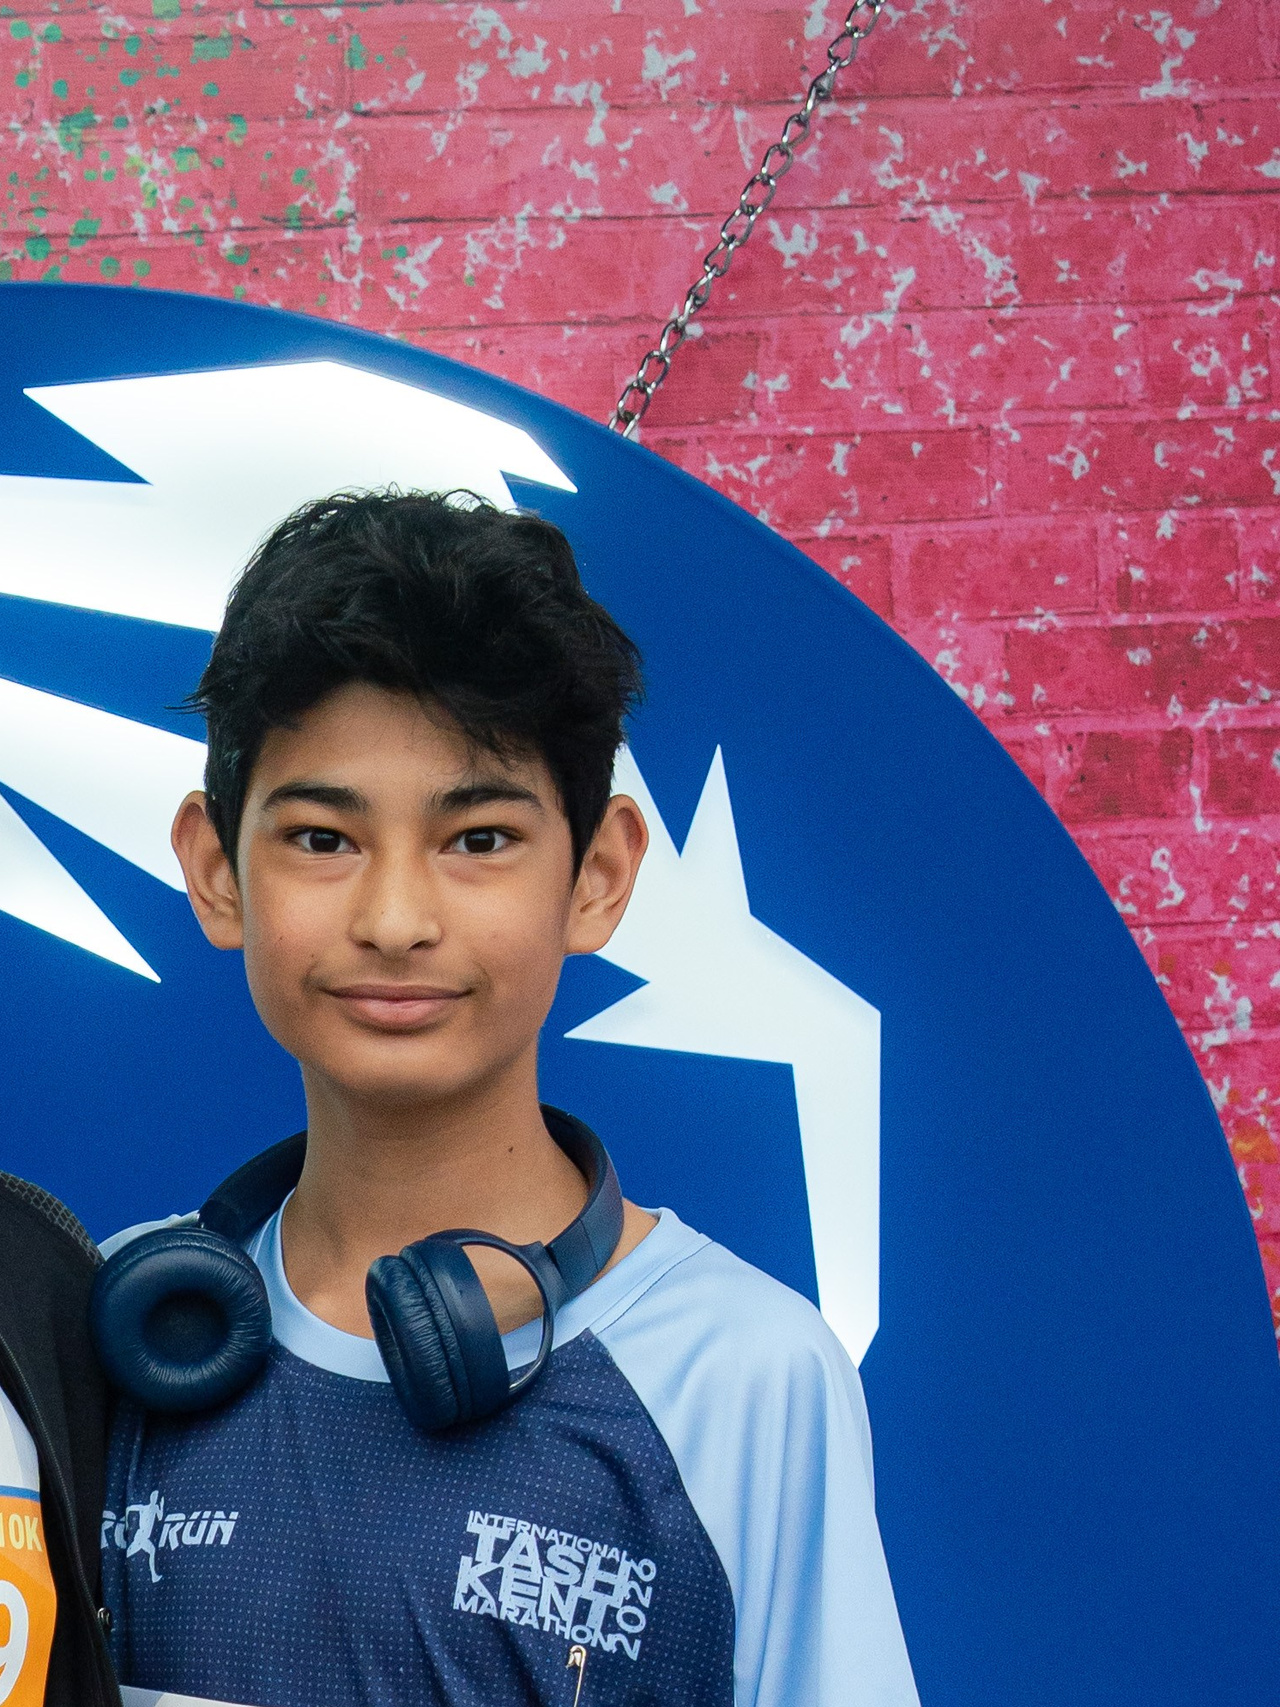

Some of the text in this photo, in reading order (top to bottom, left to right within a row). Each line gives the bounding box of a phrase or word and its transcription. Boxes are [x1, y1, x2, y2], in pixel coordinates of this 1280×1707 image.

[158, 1510, 239, 1551] RUN
[469, 1510, 631, 1564] INTERNATIONAL
[455, 1555, 621, 1630] KENT
[467, 1525, 631, 1608] TASH
[453, 1591, 614, 1652] MARATHON
[607, 1558, 657, 1661] 2026
